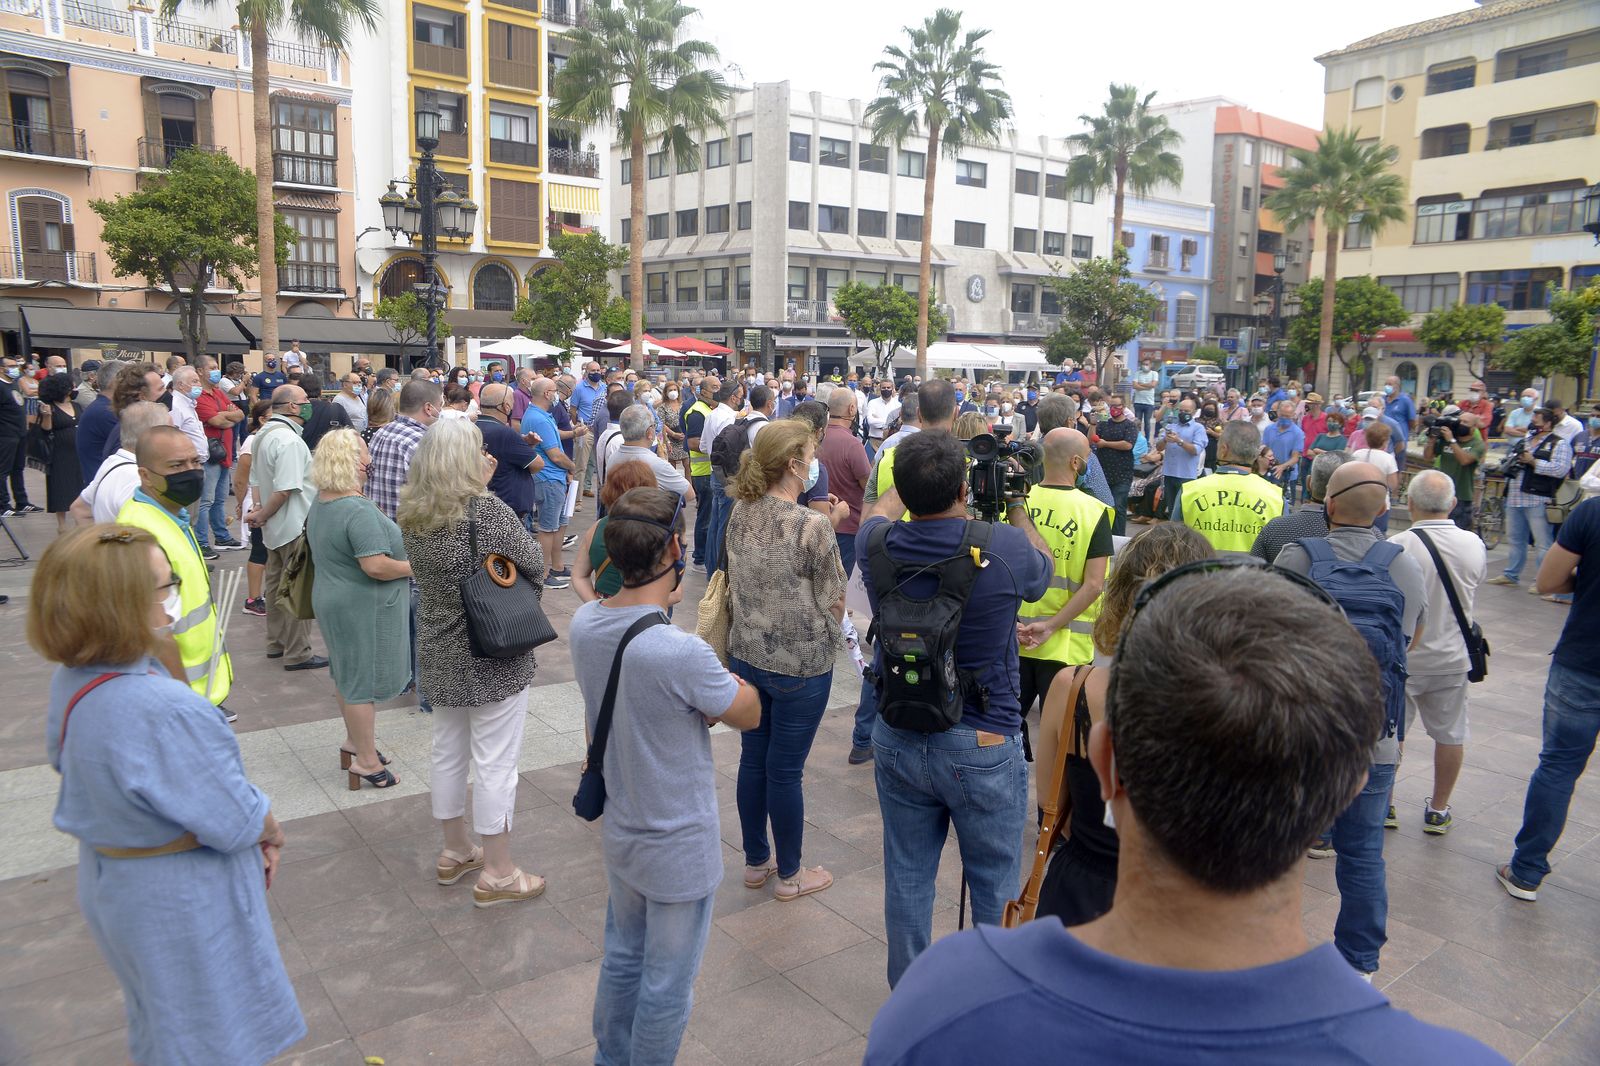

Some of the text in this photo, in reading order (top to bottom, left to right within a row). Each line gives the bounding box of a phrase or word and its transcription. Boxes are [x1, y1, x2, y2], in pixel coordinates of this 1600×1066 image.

[1193, 490, 1267, 521] U.P.L.B.
[1030, 507, 1079, 545] P.L.B.
[1192, 517, 1263, 534] Andalucía
